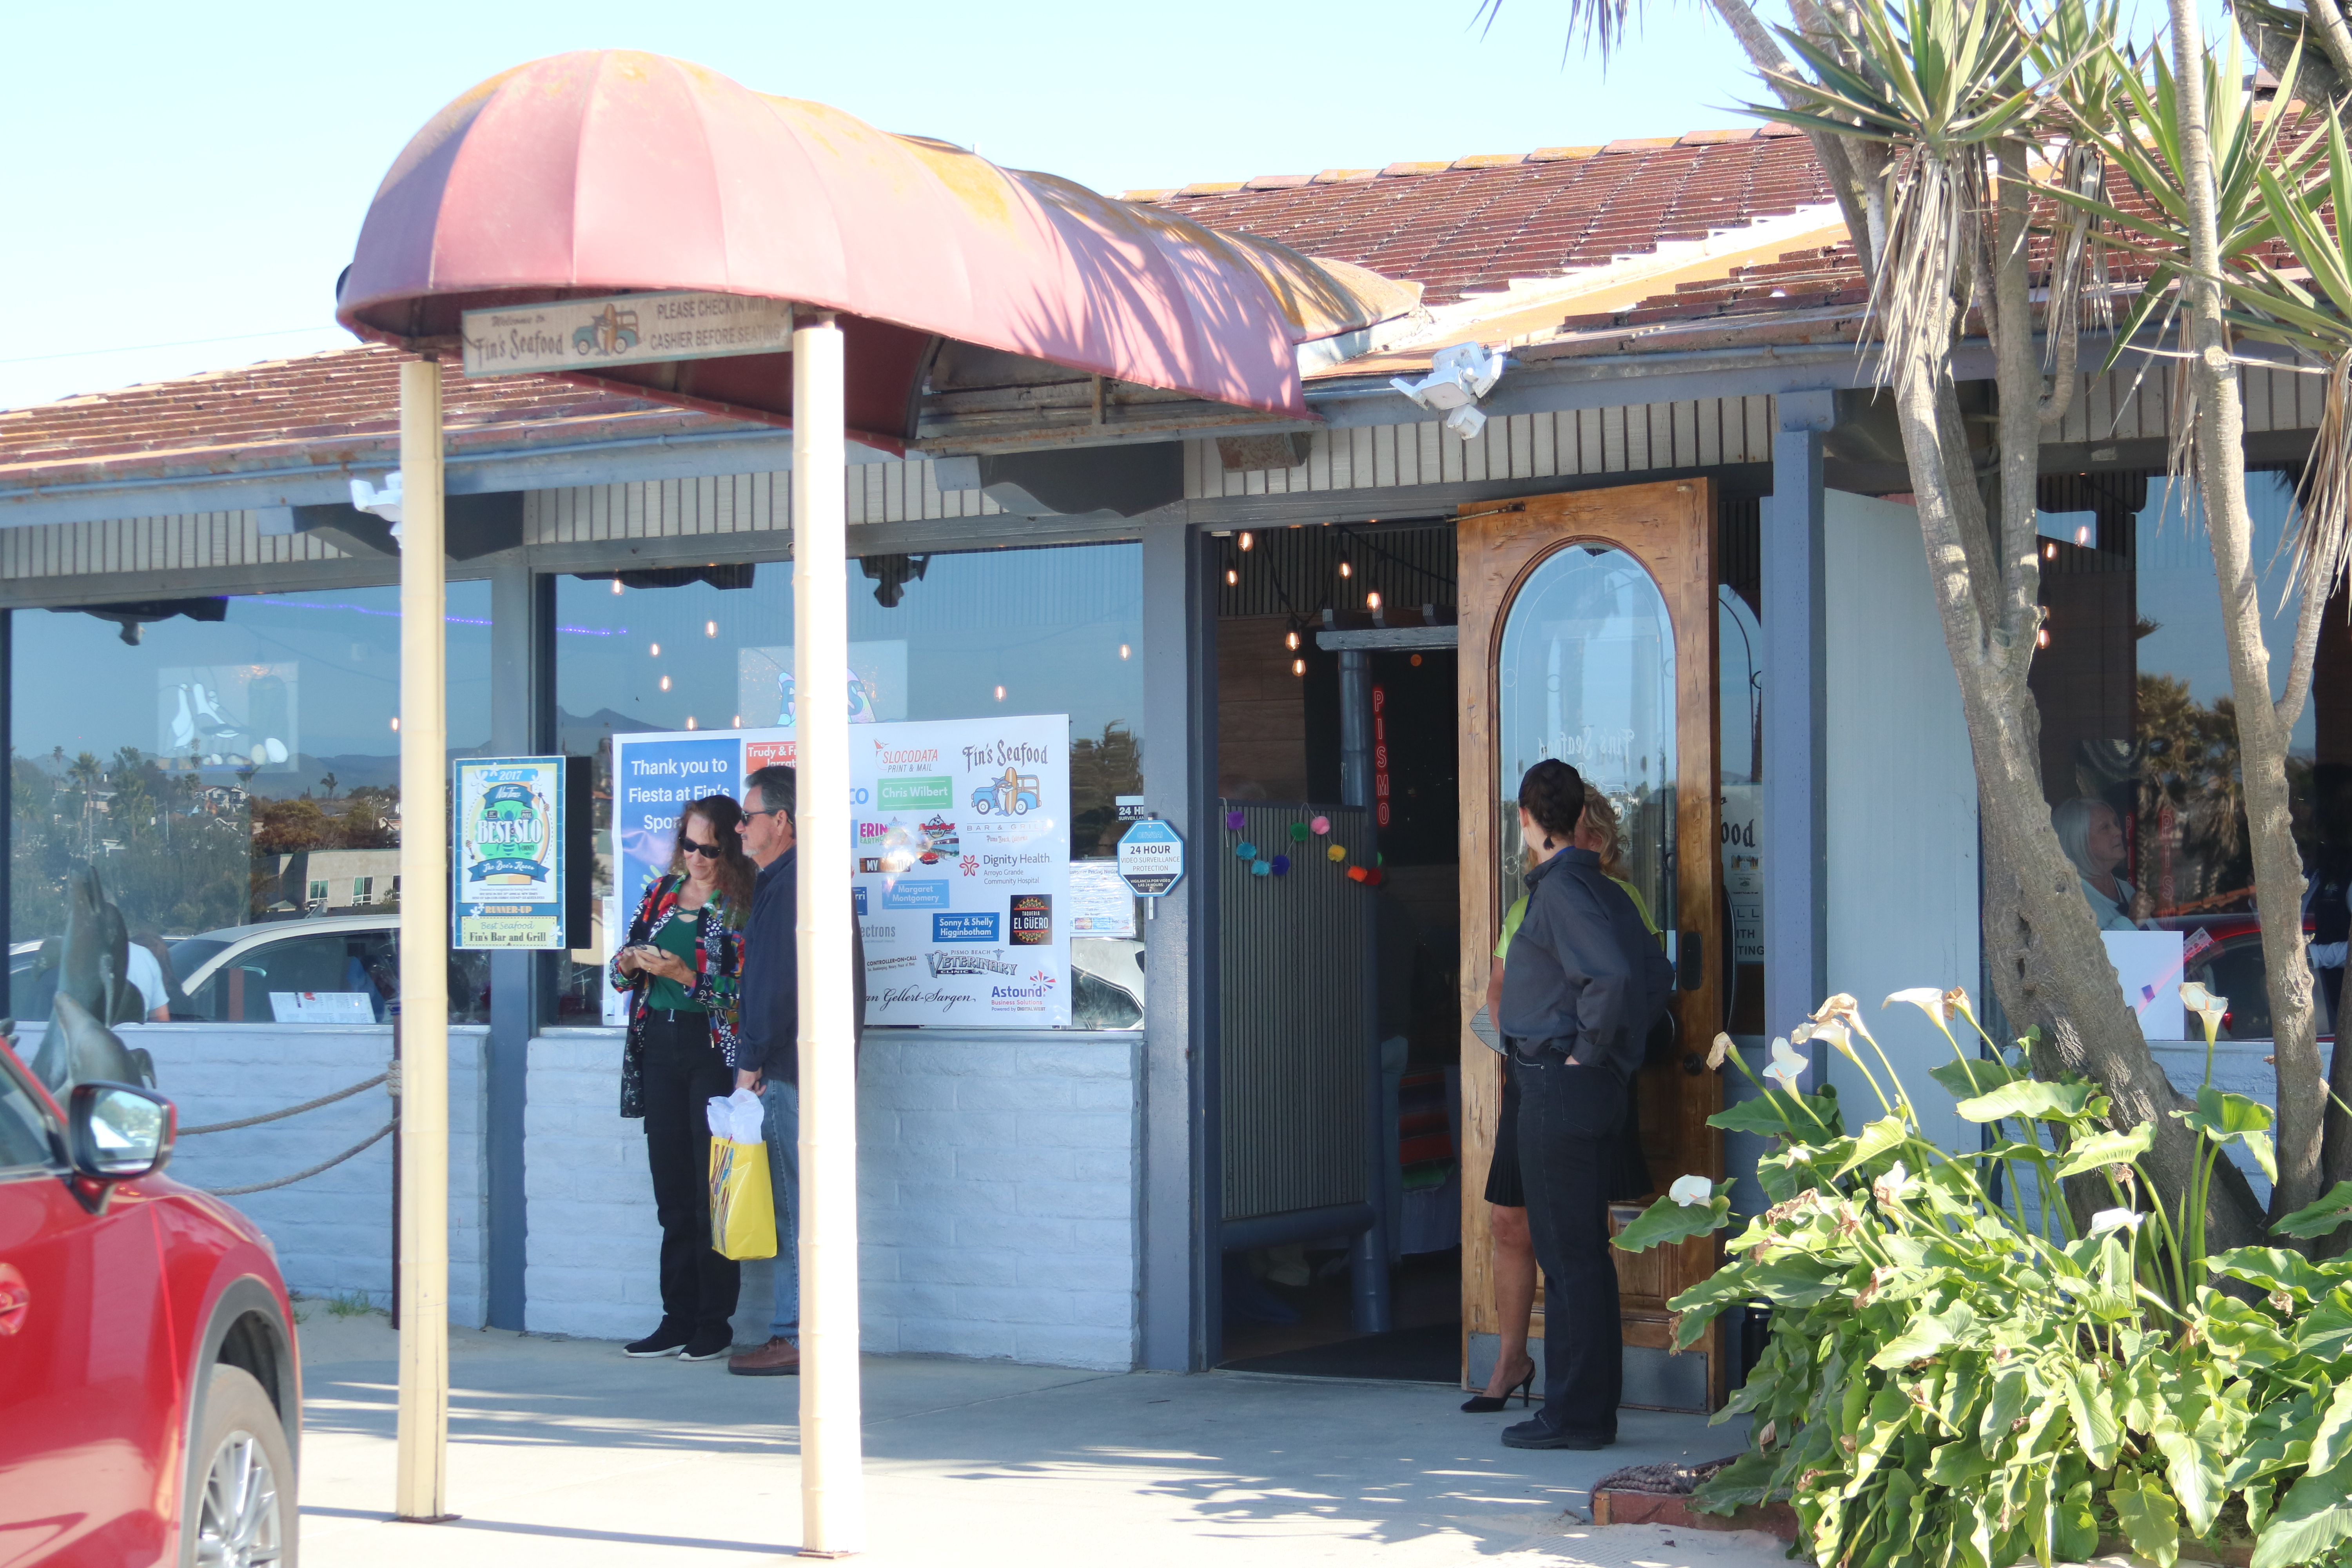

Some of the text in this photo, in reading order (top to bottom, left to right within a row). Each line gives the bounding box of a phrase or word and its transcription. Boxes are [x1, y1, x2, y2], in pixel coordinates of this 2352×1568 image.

[657, 301, 696, 319] PLEASE
[698, 298, 732, 316] CHECK
[735, 297, 744, 312] IN
[650, 324, 780, 350] CASHIER BEFORE SEATING
[475, 328, 564, 369] Fin's Seafood
[748, 746, 776, 759] Trudy
[778, 746, 787, 756] &
[882, 749, 938, 764] SLOCODATA
[962, 739, 1049, 773] Fin's Seafood
[1374, 691, 1389, 824] PISMO
[631, 758, 728, 778] Thank you to
[916, 764, 932, 772] MAIL
[499, 770, 523, 780] 2017
[629, 788, 672, 802] Fiesta
[676, 787, 690, 801] at
[882, 786, 948, 798] Chris Wilbert
[1119, 807, 1131, 815] 24
[477, 818, 543, 844] BEST SLO
[860, 823, 889, 837] ERIN
[1130, 845, 1171, 855] 24 HOUR
[984, 853, 1050, 867] Dignity Health
[1018, 877, 1040, 885] Hospital
[898, 885, 933, 894] Margaret
[893, 894, 939, 903] Montgomery
[499, 921, 535, 931] Seafood
[939, 918, 962, 929] Sonny
[971, 917, 993, 927] Shelly
[1014, 916, 1049, 929] EL GÜERO
[470, 932, 546, 942] Fin's Bar and Grill
[940, 926, 991, 938] Higginbotham
[925, 950, 1018, 978] VETERINARY
[991, 985, 1042, 997] Astound
